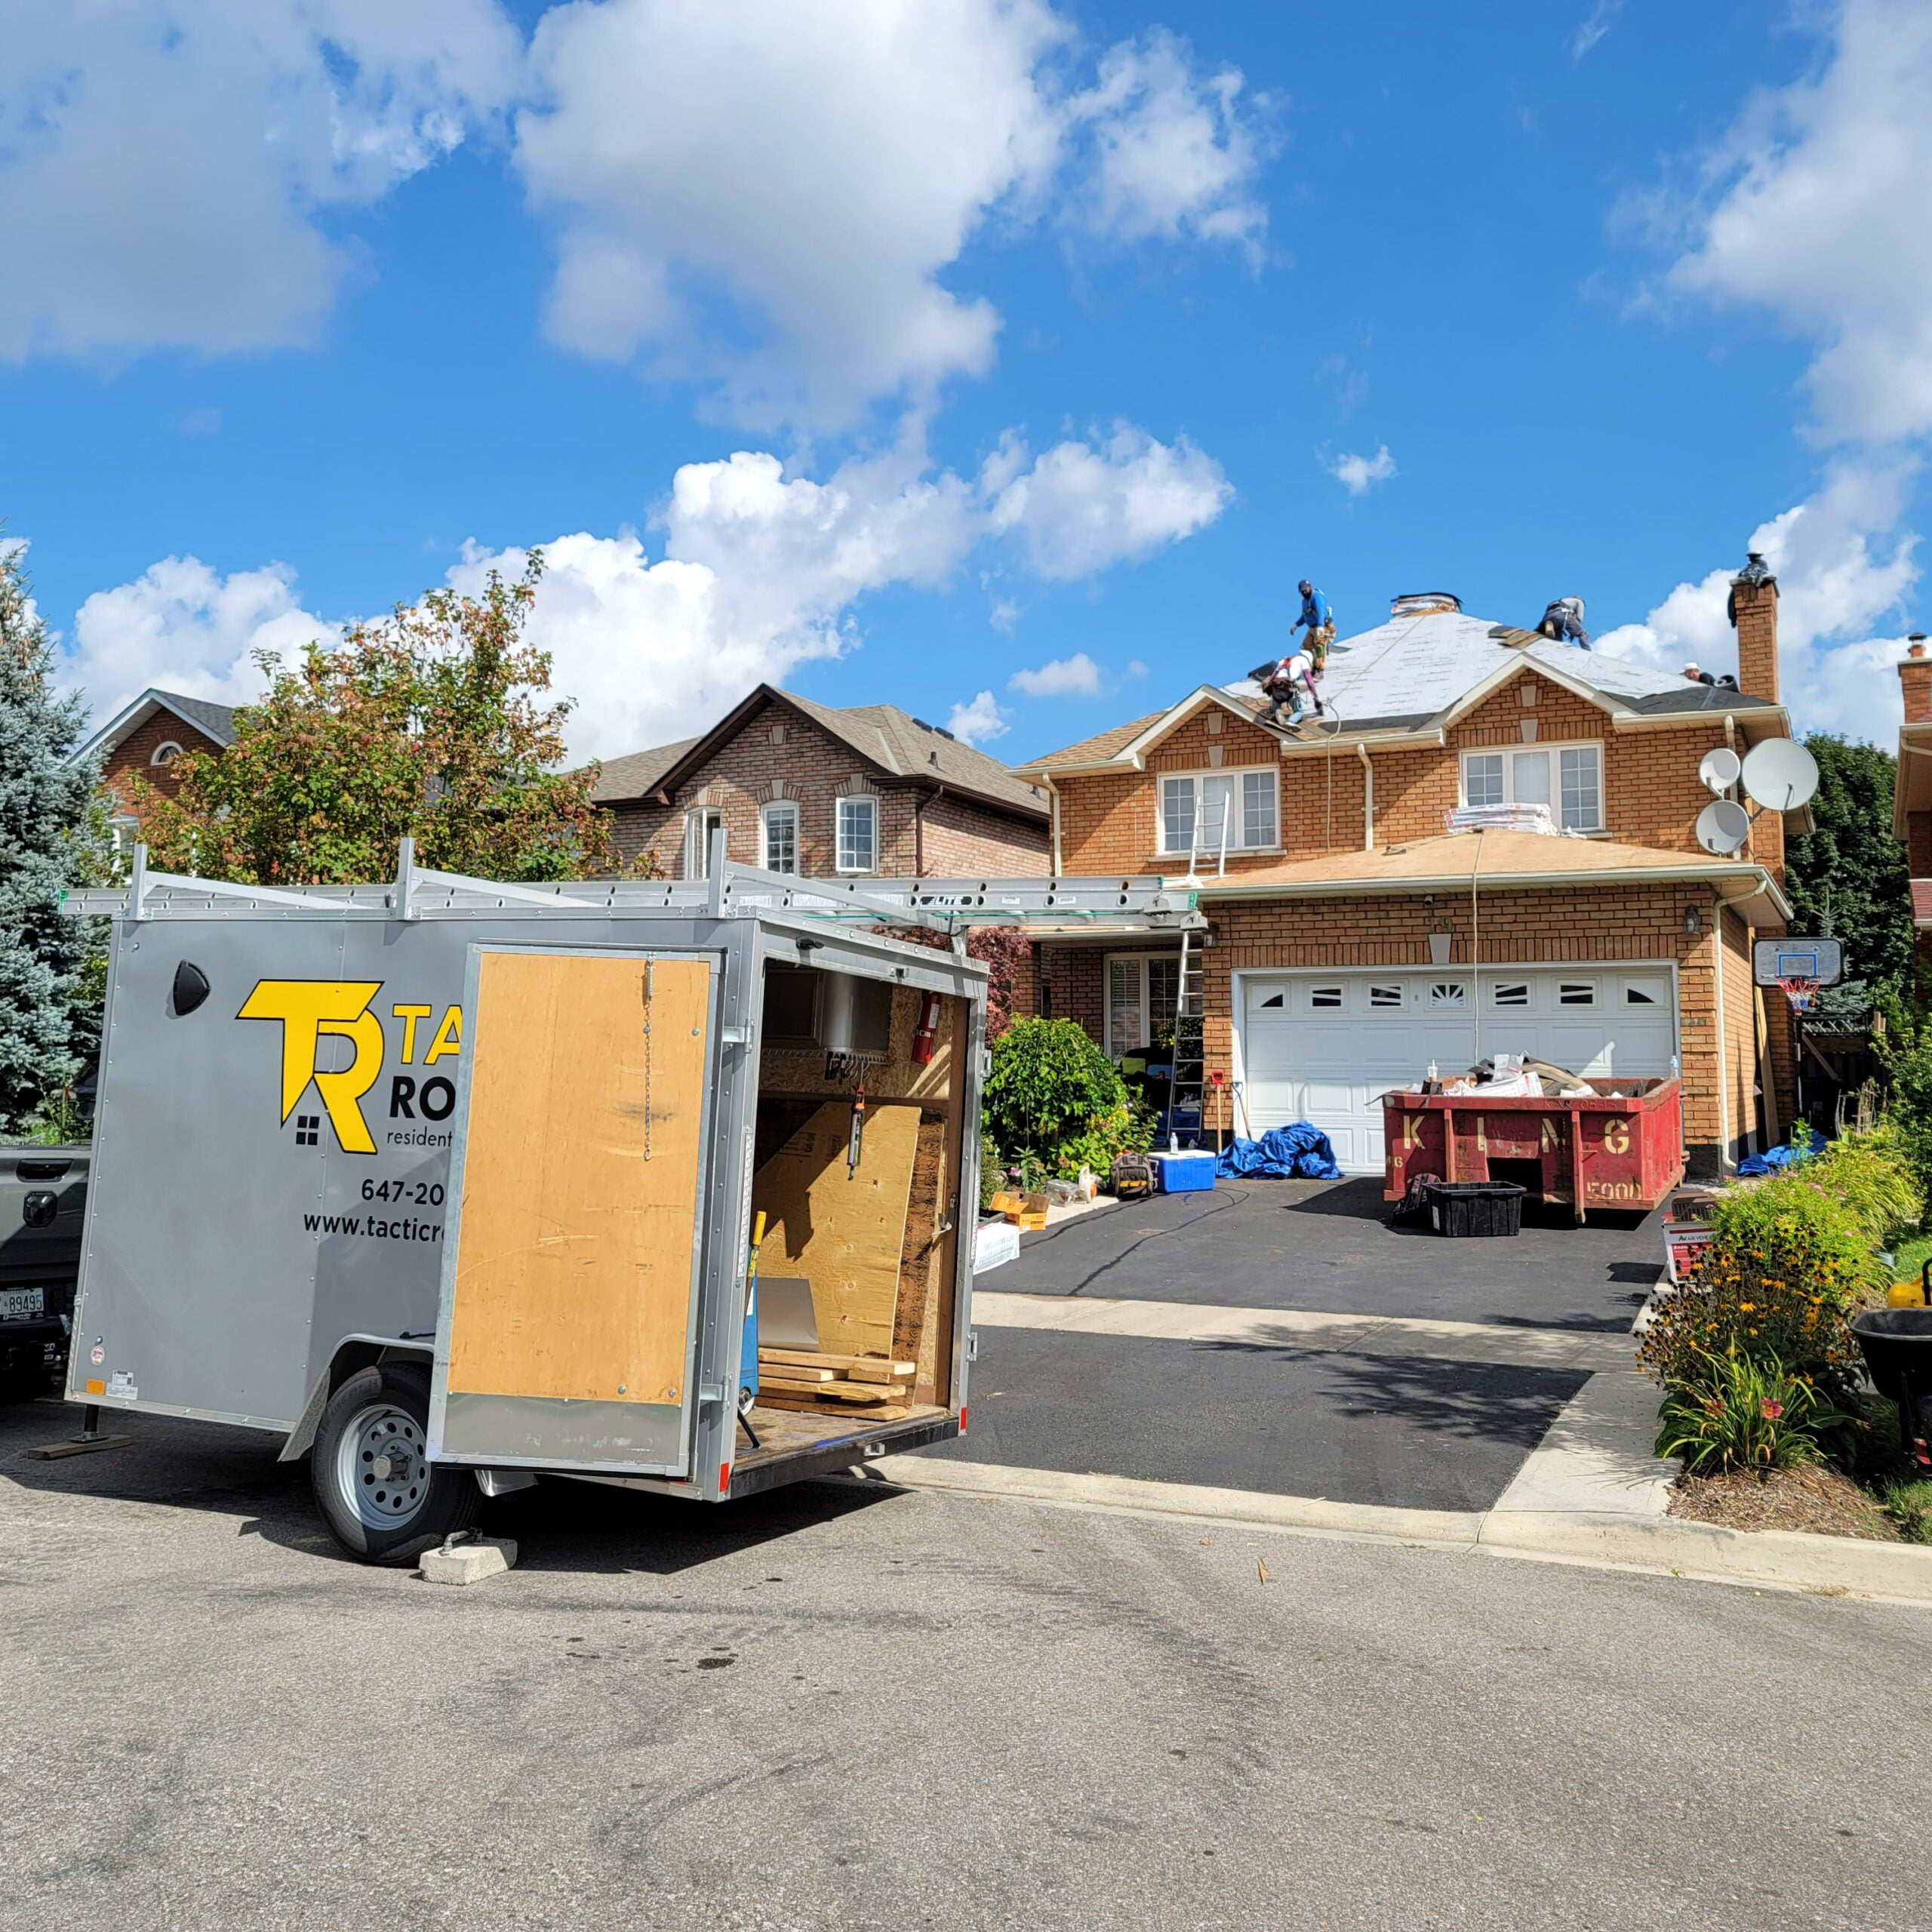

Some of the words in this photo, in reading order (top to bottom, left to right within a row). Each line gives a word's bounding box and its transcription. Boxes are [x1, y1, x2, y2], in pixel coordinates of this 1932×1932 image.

[928, 896, 964, 905] ELITE
[392, 1004, 463, 1065] TA
[389, 1075, 457, 1121] RO
[387, 1125, 453, 1147] resident
[361, 1179, 445, 1206] 647-20
[303, 1214, 445, 1243] www.tacticr
[9, 1294, 42, 1312] 89495
